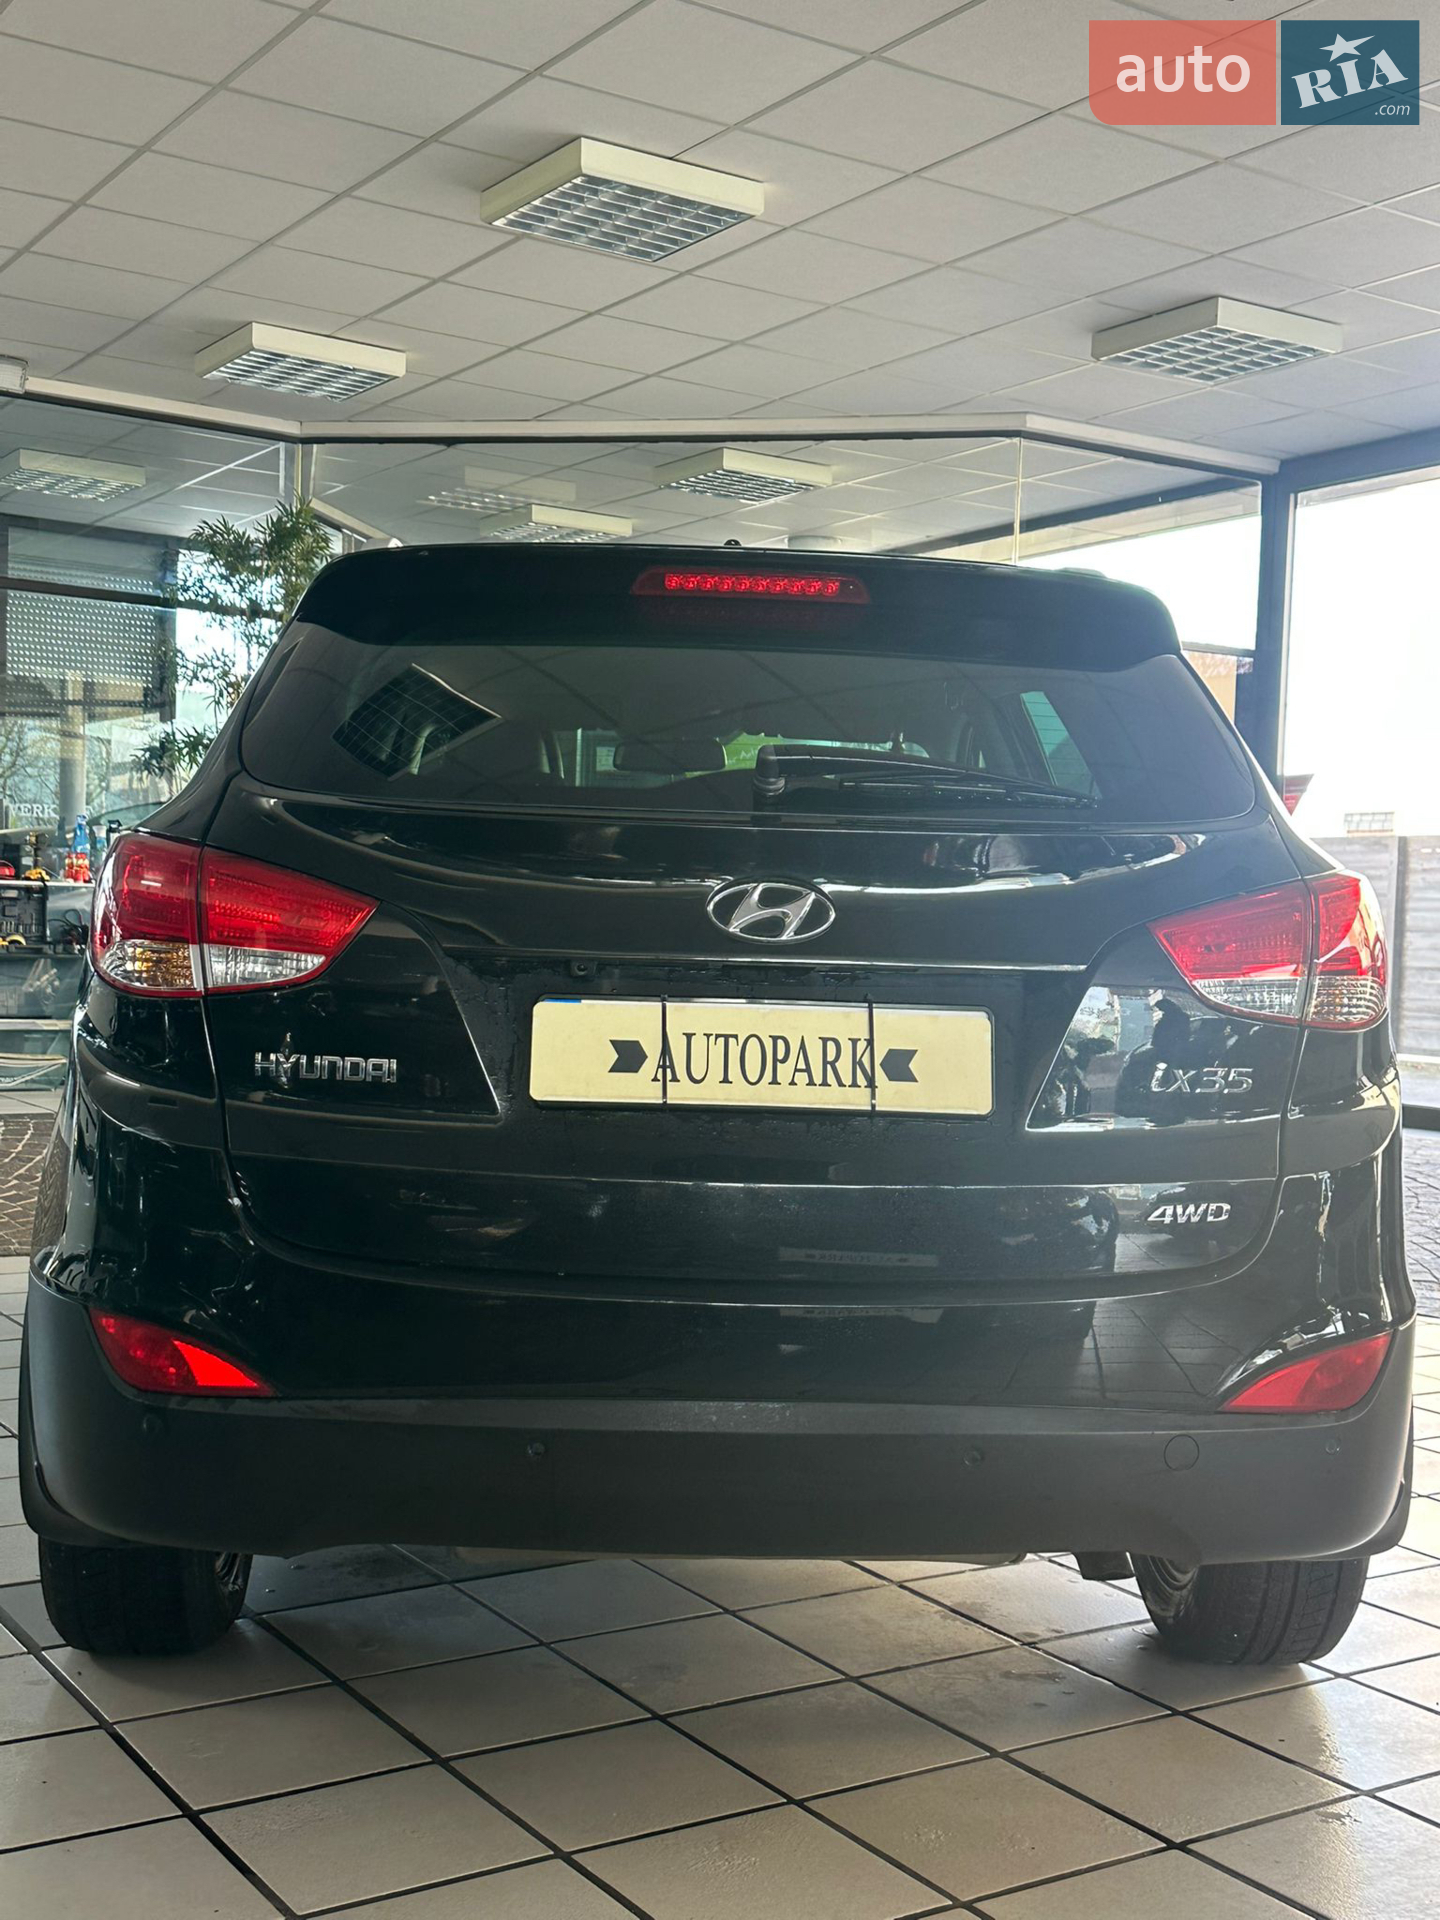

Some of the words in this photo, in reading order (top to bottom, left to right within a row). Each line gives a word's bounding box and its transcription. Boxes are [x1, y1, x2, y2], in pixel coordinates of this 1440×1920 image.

[255, 1052, 397, 1083] HYUNDAI
[651, 1031, 878, 1089] AUTOPARK
[1151, 1062, 1254, 1094] ix35
[1147, 1202, 1231, 1224] 4WD
